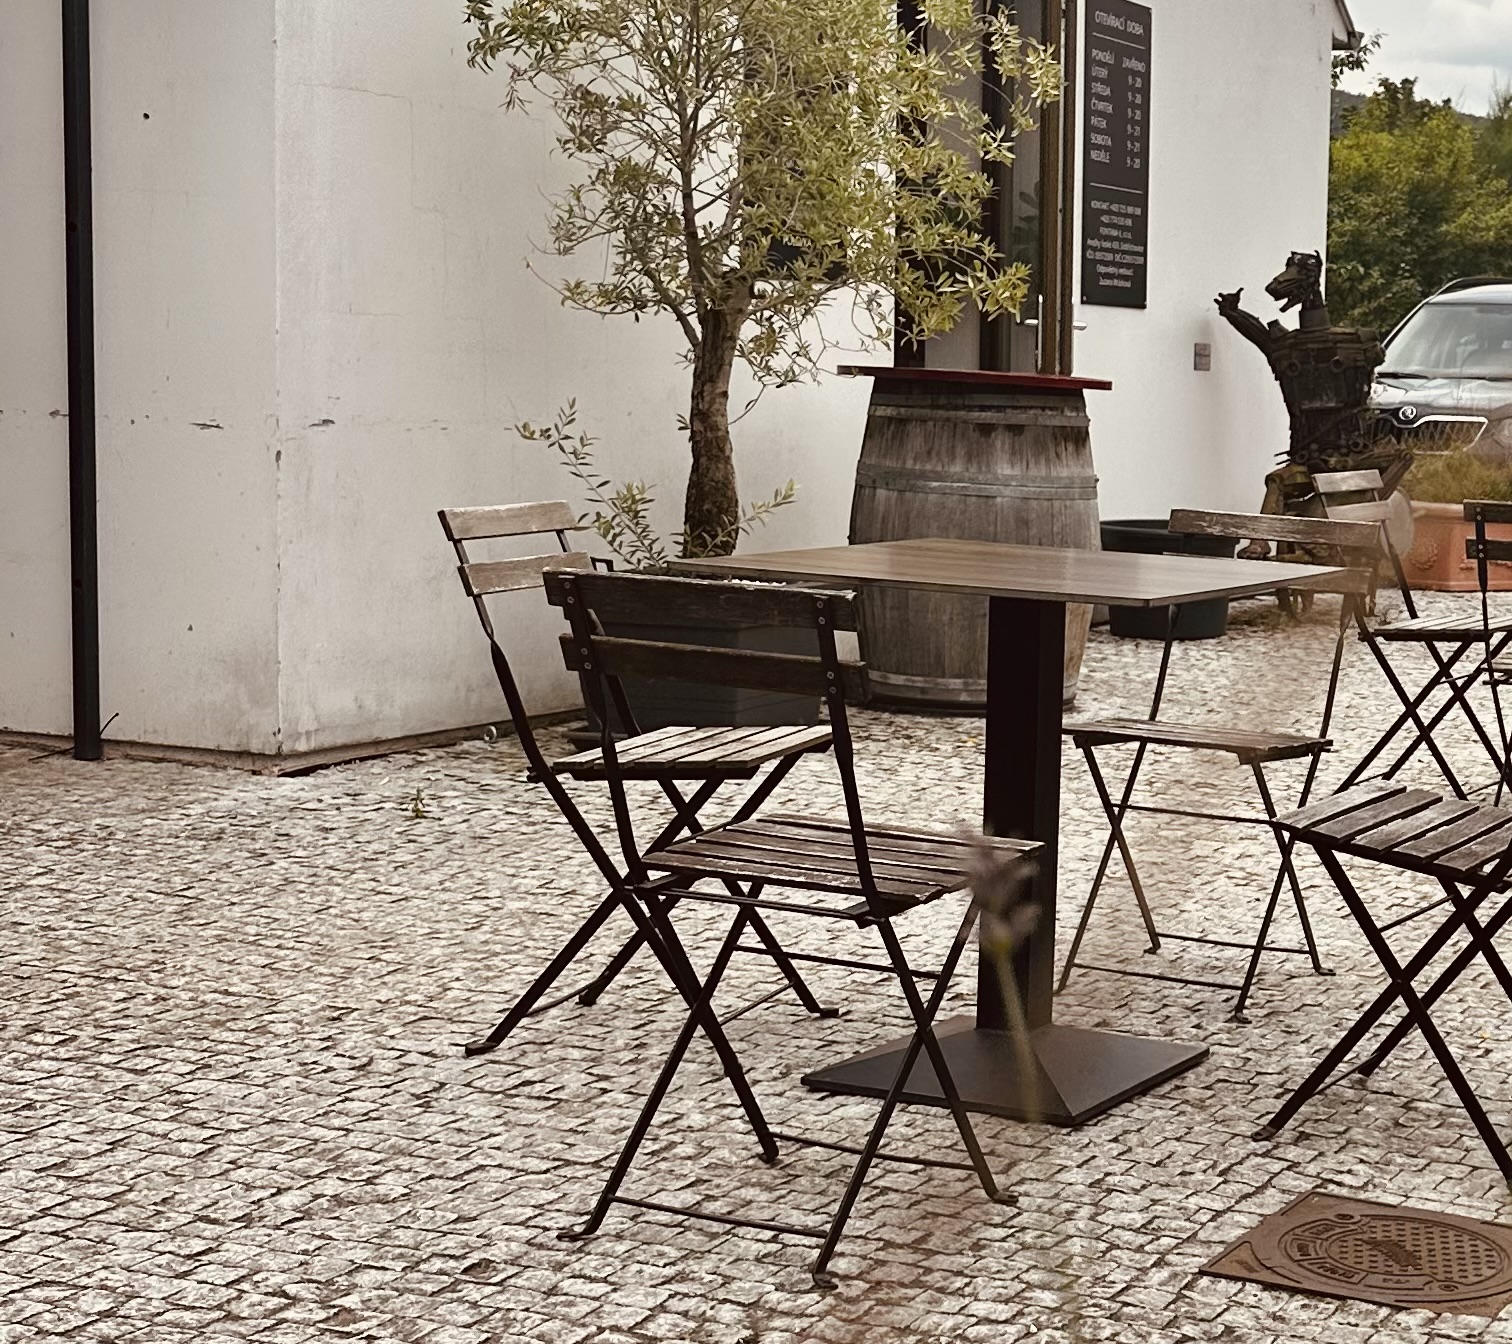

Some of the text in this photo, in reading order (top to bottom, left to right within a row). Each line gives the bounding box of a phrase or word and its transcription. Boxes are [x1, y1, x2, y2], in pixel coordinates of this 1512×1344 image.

[1095, 11, 1144, 36] OTEVÍRACÍ DOBA
[1092, 48, 1146, 73] PONDĚLÍ ZAVŘENO
[1090, 132, 1111, 146] SOBOTA
